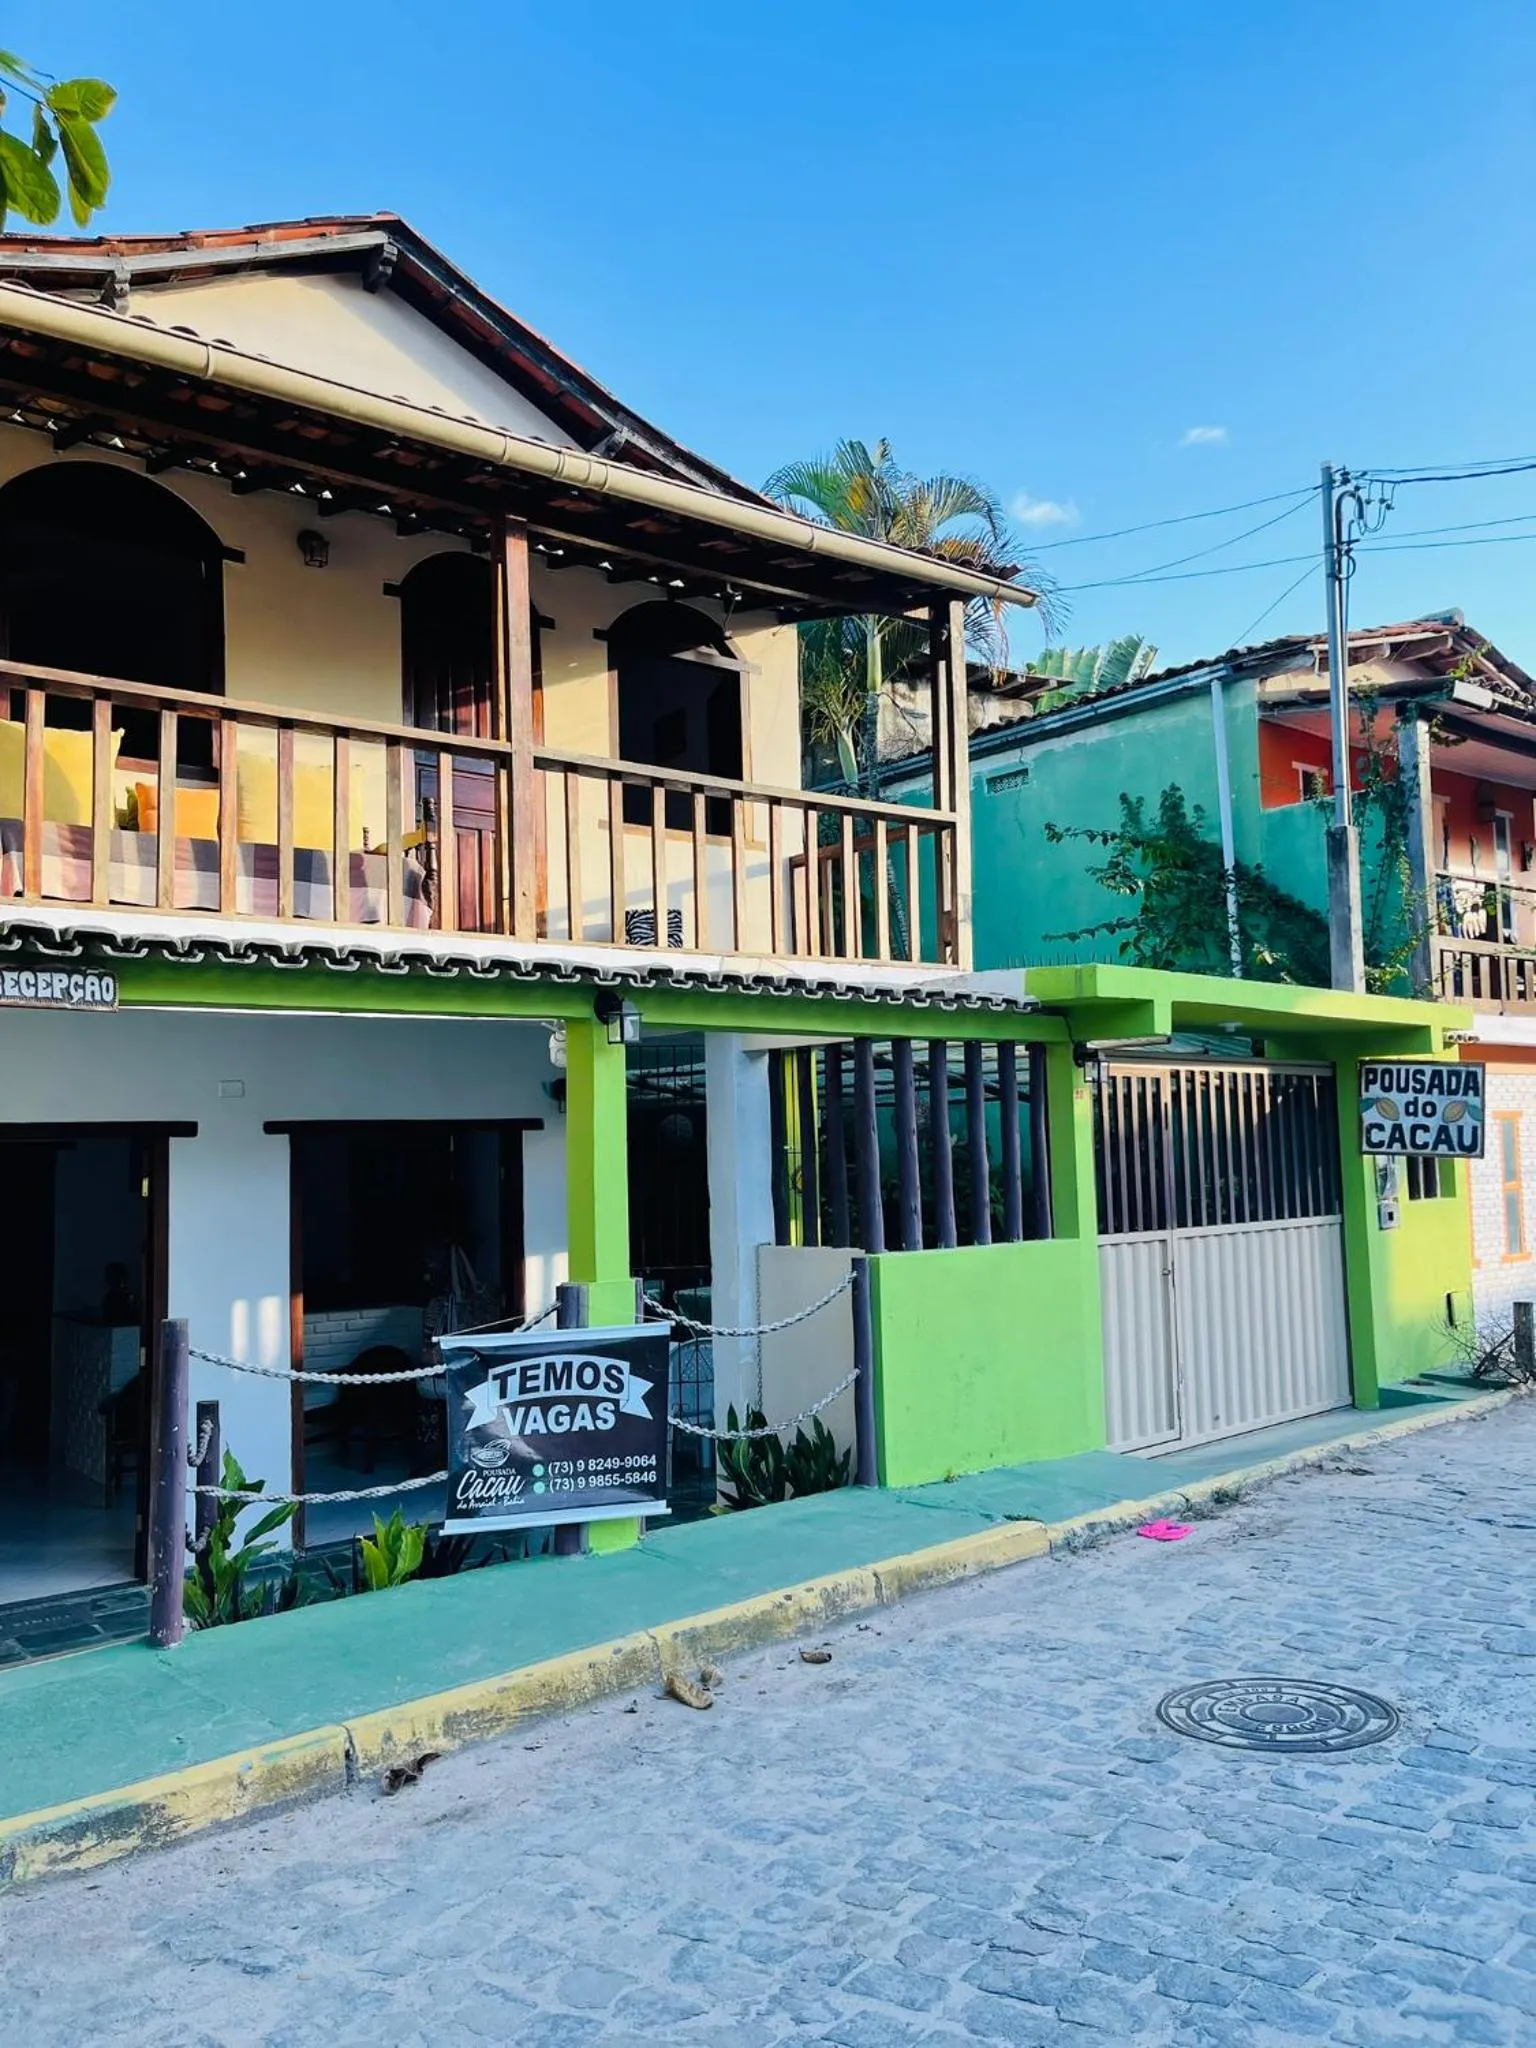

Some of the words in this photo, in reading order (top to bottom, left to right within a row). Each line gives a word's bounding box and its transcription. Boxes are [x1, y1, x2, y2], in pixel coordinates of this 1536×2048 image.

[0, 970, 114, 1002] ECEPÇÃO
[1363, 1067, 1480, 1097] POUSADA
[1404, 1096, 1437, 1118] do
[1365, 1123, 1479, 1153] CACAU
[491, 1361, 625, 1400] TEMOS
[502, 1401, 617, 1436] VAGAS
[483, 1468, 516, 1476] POUSADA
[548, 1461, 574, 1477] (73)
[576, 1460, 585, 1472] 9
[588, 1454, 657, 1471] 8249-9064
[456, 1470, 526, 1500] Cacau
[549, 1477, 575, 1493] (73)
[577, 1476, 586, 1489] 9
[588, 1471, 657, 1488] 9855-5846
